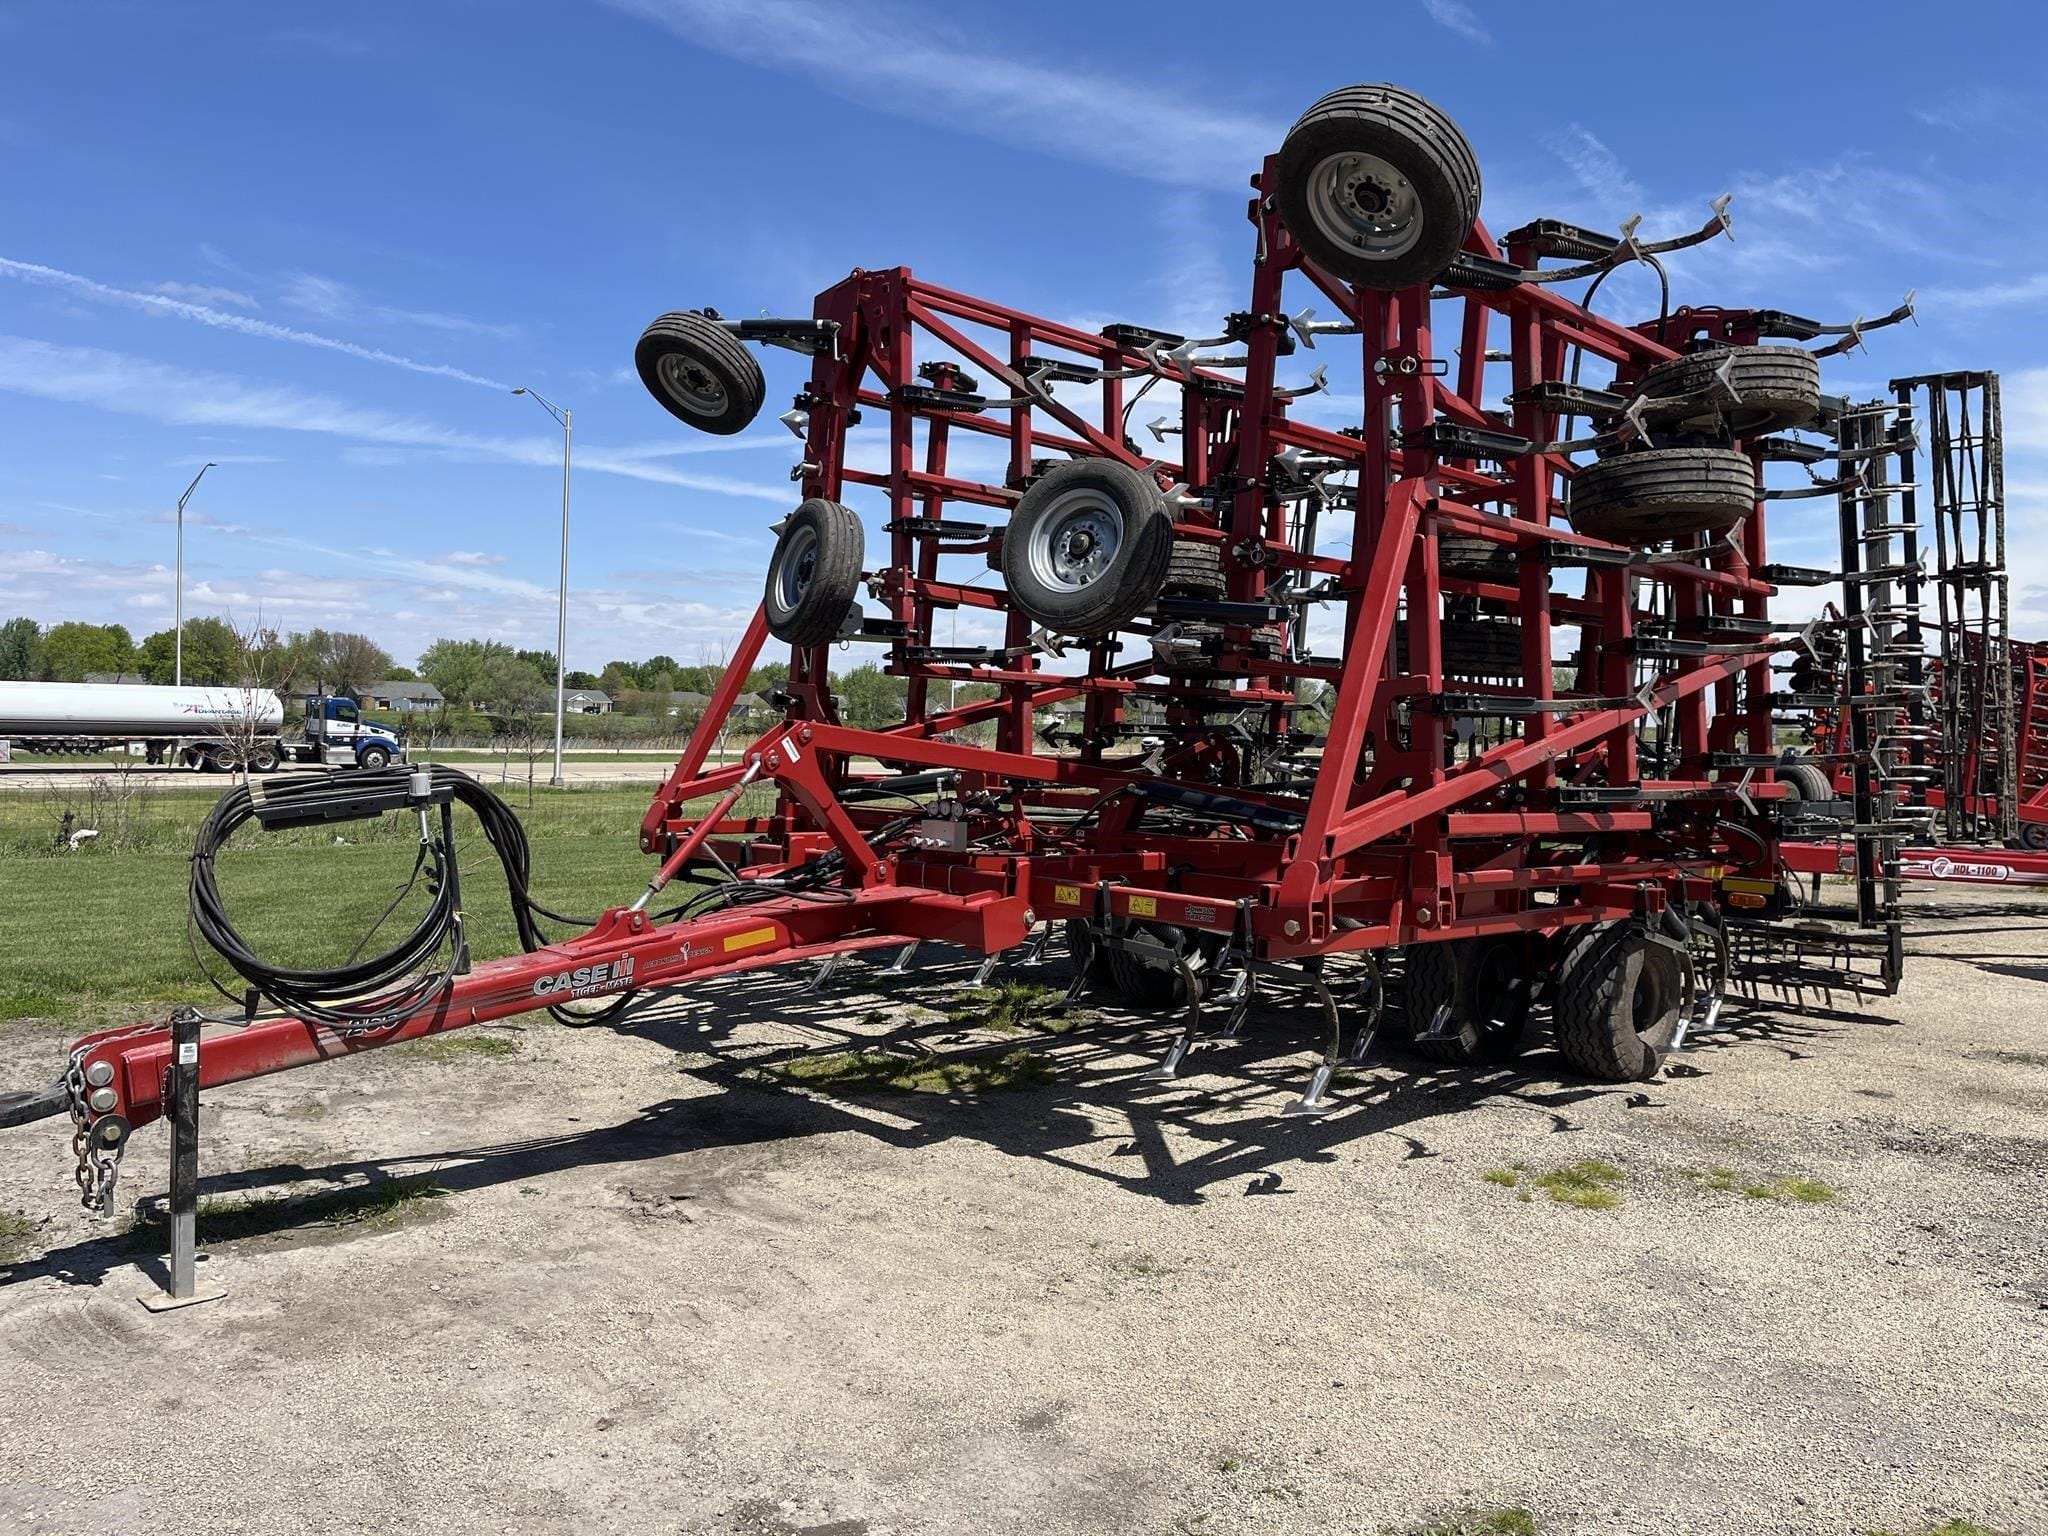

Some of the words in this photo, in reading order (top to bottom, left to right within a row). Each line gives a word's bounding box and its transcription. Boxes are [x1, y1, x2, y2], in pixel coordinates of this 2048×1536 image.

[1953, 864, 1998, 876] HDL-1100
[1185, 904, 1216, 915] JOHNSON
[1185, 912, 1216, 923] TRACTOR
[533, 962, 610, 996] CASE
[571, 976, 633, 998] TIGER-MATE
